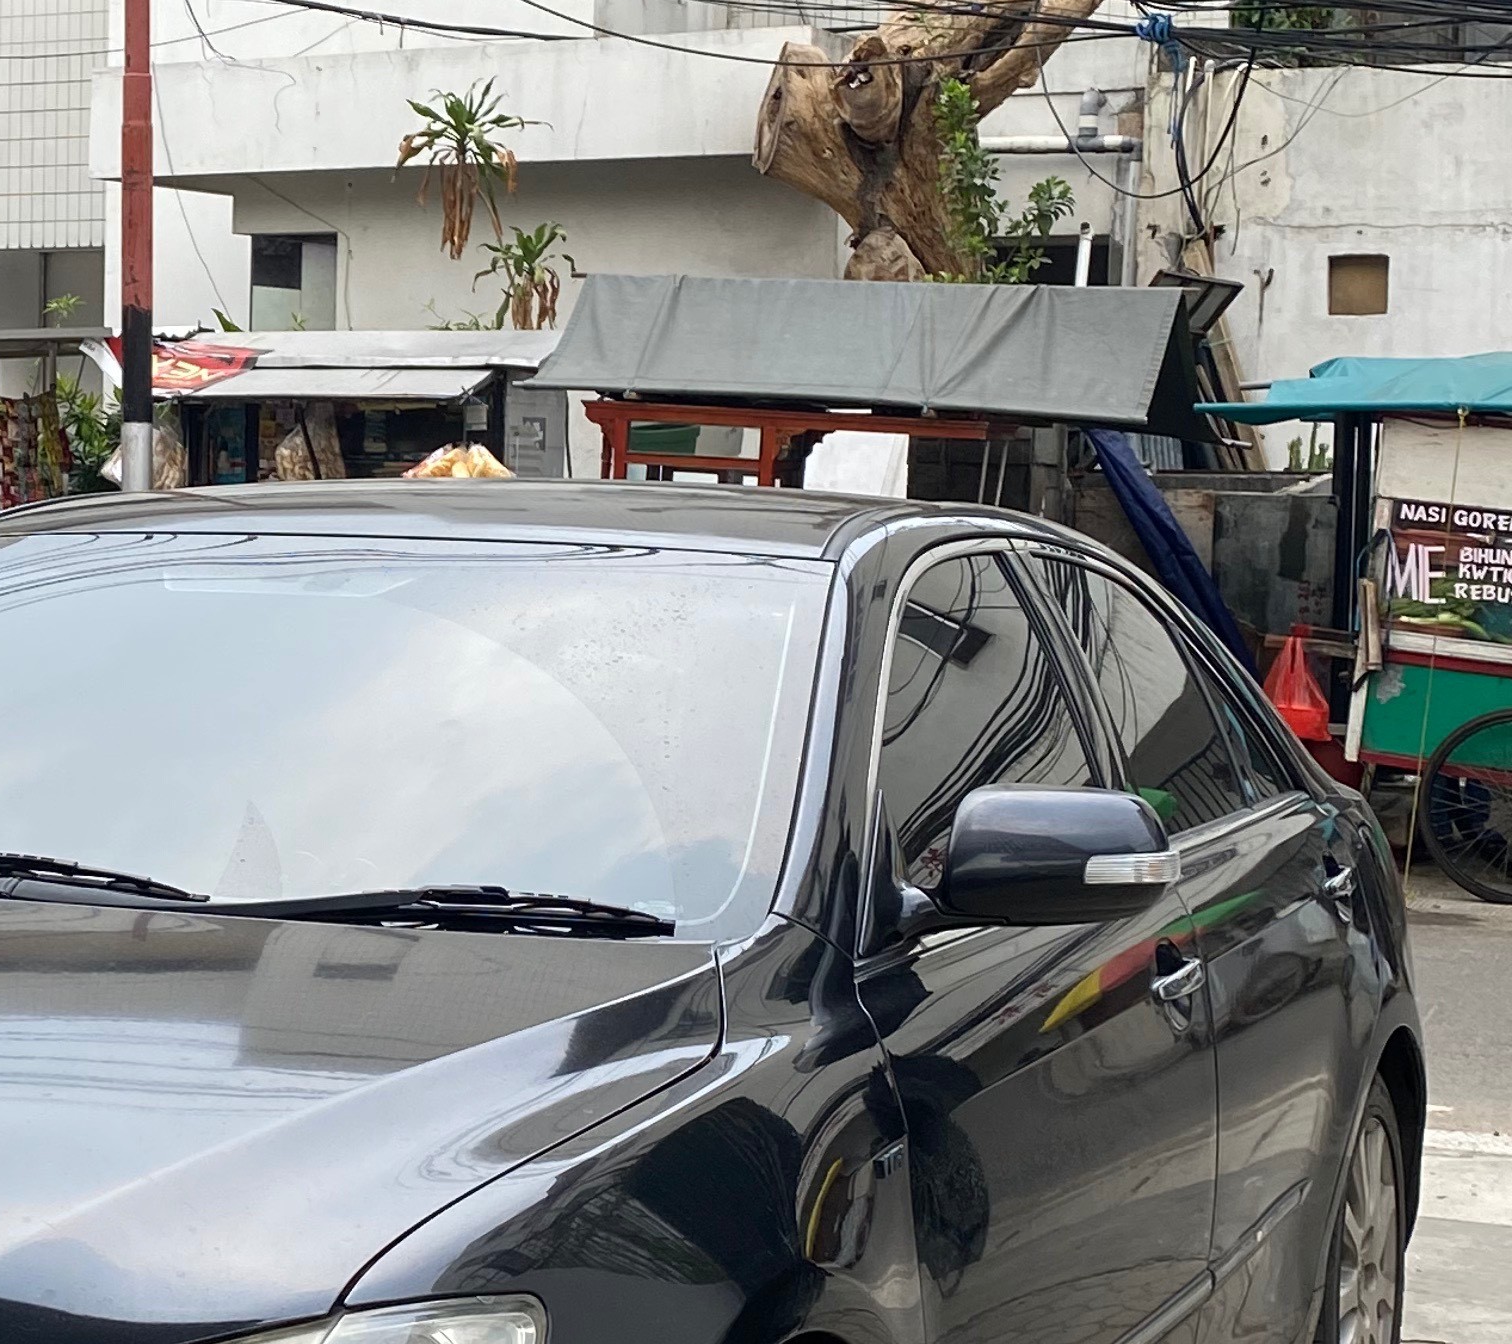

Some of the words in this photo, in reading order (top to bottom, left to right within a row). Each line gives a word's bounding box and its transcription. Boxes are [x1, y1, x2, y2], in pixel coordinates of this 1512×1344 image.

[1400, 504, 1447, 523] NASI
[1453, 509, 1512, 531] GORE
[1453, 582, 1512, 604] REBU
